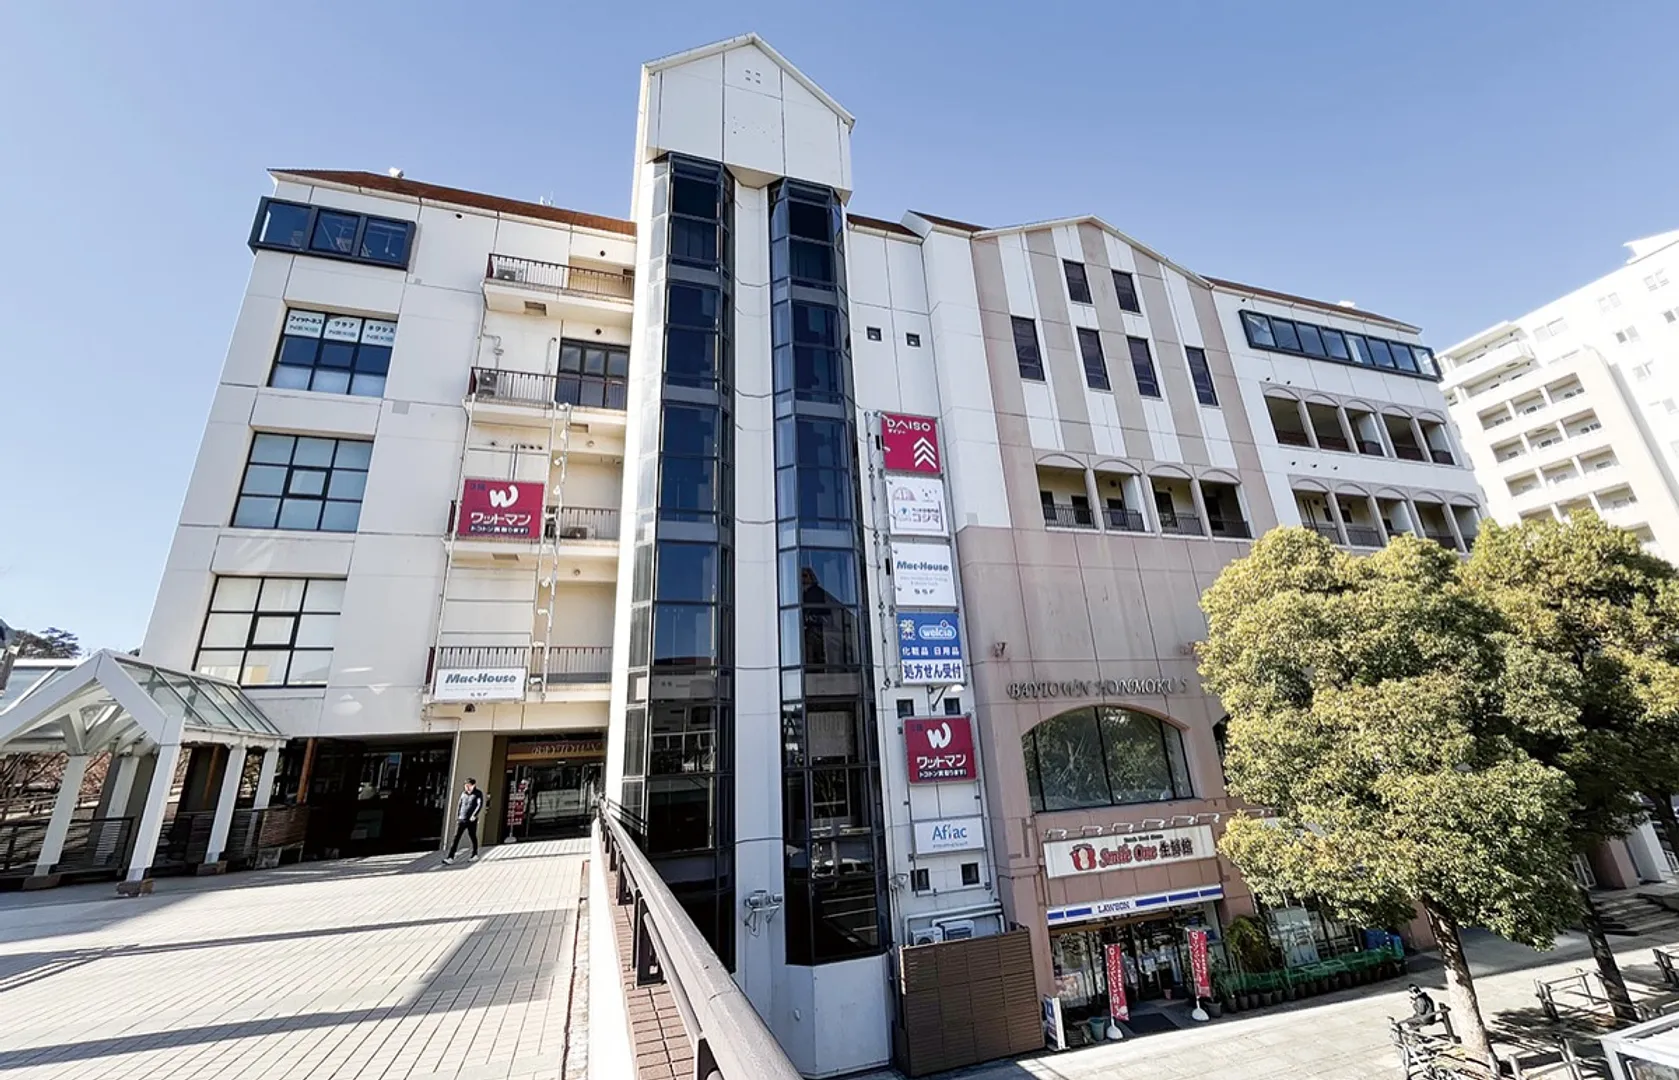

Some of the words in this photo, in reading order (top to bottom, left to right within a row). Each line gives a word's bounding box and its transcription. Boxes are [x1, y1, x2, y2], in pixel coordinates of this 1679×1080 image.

[887, 419, 931, 431] DAISO
[471, 511, 532, 527] ワットマン
[902, 646, 929, 656] 化粧品
[934, 646, 960, 656] 日用品
[903, 663, 961, 680] 処方せん受付
[916, 754, 967, 769] ワットマン
[1134, 844, 1158, 862] One
[1097, 900, 1130, 914] LAWSON
